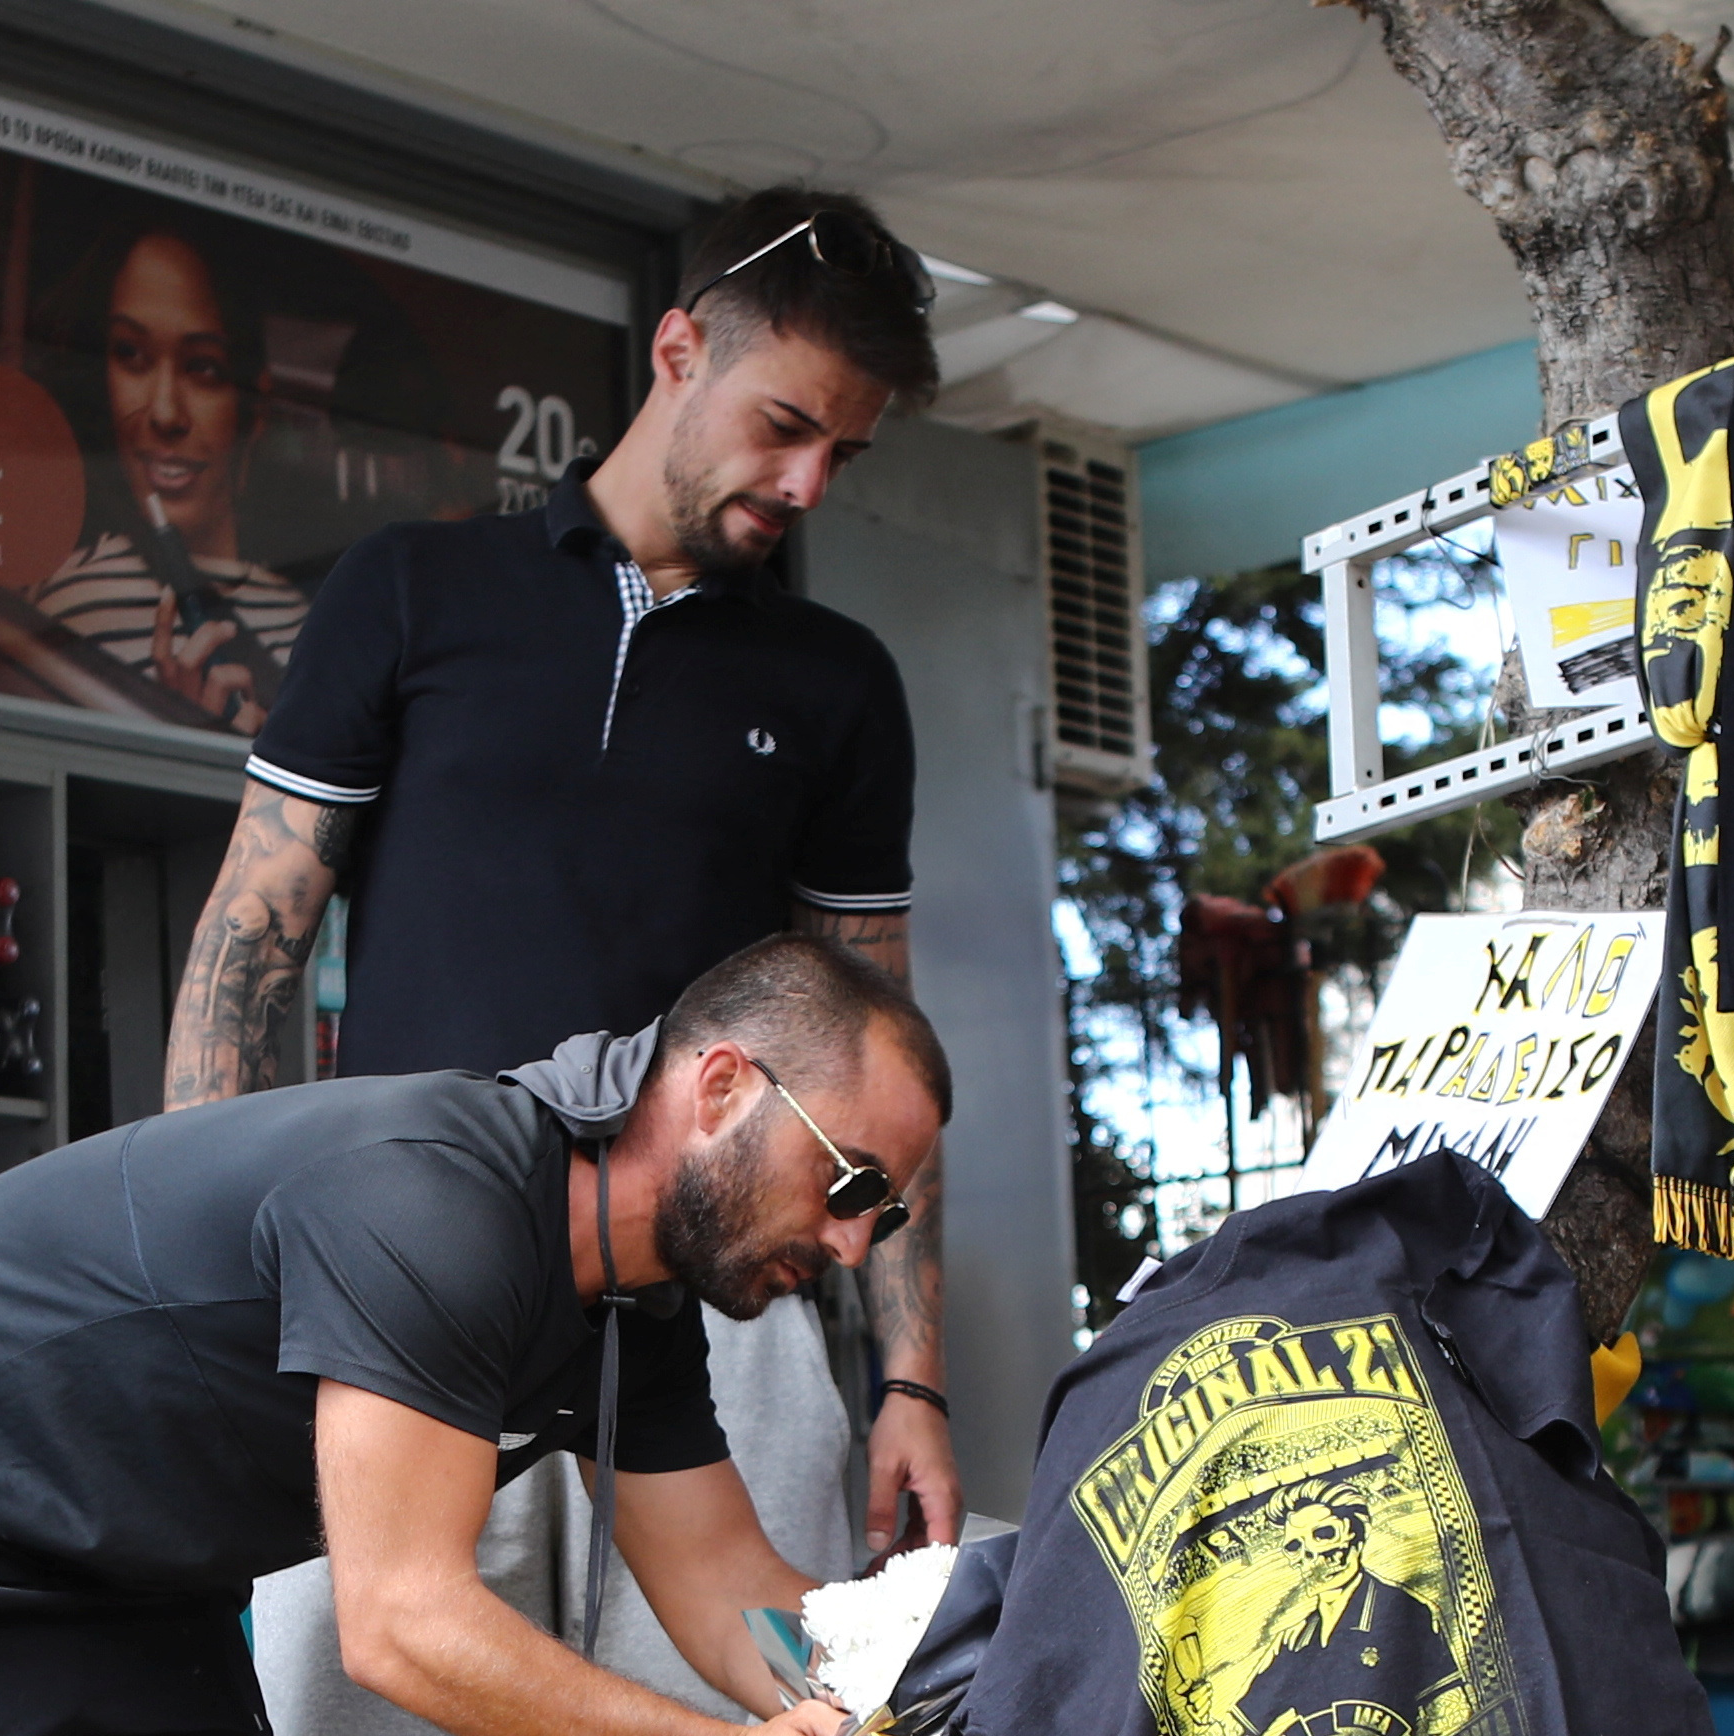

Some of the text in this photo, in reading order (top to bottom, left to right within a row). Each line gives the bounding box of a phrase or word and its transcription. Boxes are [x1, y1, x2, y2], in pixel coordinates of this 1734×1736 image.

[1474, 924, 1636, 1018] ΚΑΛΟ
[1358, 1025, 1623, 1106] ΠΑΡΑΔΕΙΣΟ
[1185, 1344, 1234, 1384] 1982
[1080, 1323, 1422, 1568] ORIGINAL 21
[1353, 1705, 1392, 1735] ΙΔΕΑ
